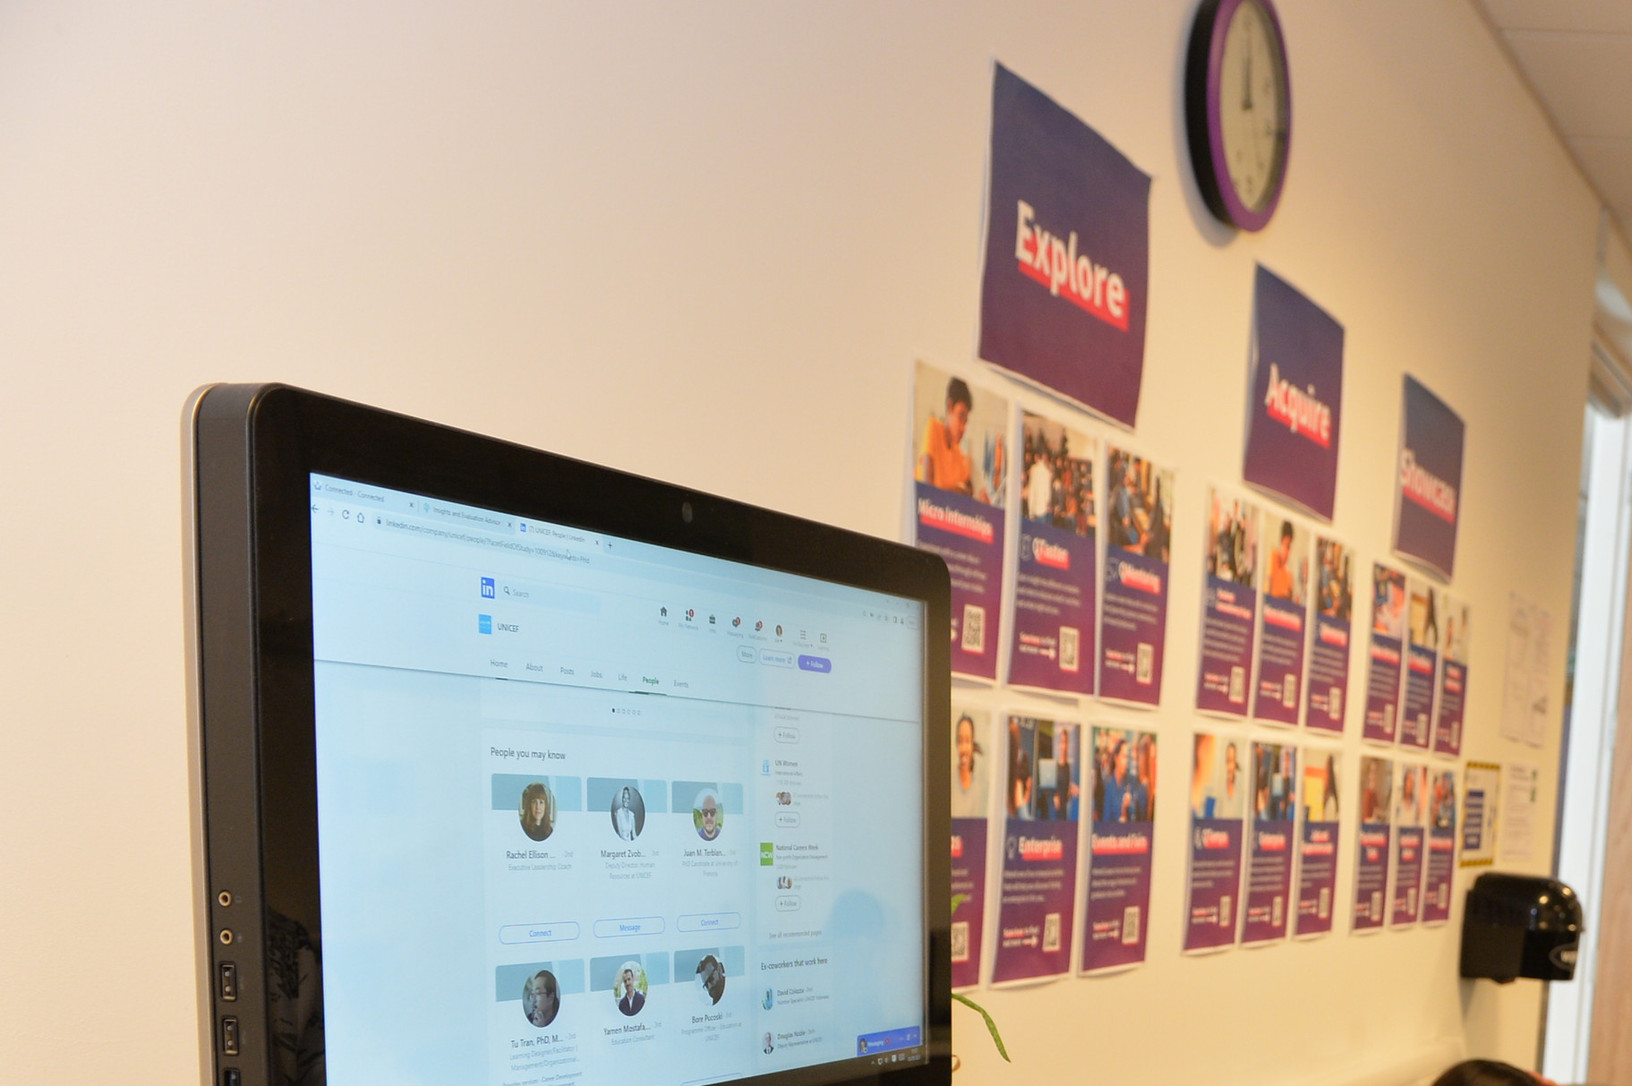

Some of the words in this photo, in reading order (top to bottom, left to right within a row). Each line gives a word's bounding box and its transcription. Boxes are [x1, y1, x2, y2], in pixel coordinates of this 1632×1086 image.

[1015, 200, 1124, 318] Explore
[1264, 362, 1331, 439] Acquire
[918, 498, 944, 521] Micro
[497, 623, 519, 633] UNICEF
[490, 659, 508, 670] Home
[526, 663, 543, 673] About
[642, 675, 659, 687] People
[491, 747, 515, 759] People
[516, 750, 529, 760] you
[531, 751, 546, 761] may
[547, 750, 566, 760] know
[1019, 836, 1062, 856] Enterprise
[506, 850, 527, 859] Rachel
[528, 849, 549, 859] Ellison
[600, 849, 626, 860] Margaret
[683, 849, 695, 857] Juan
[700, 919, 719, 927] Connect
[529, 929, 552, 938] Connect
[619, 924, 641, 933] Message
[511, 1039, 519, 1048] Tu
